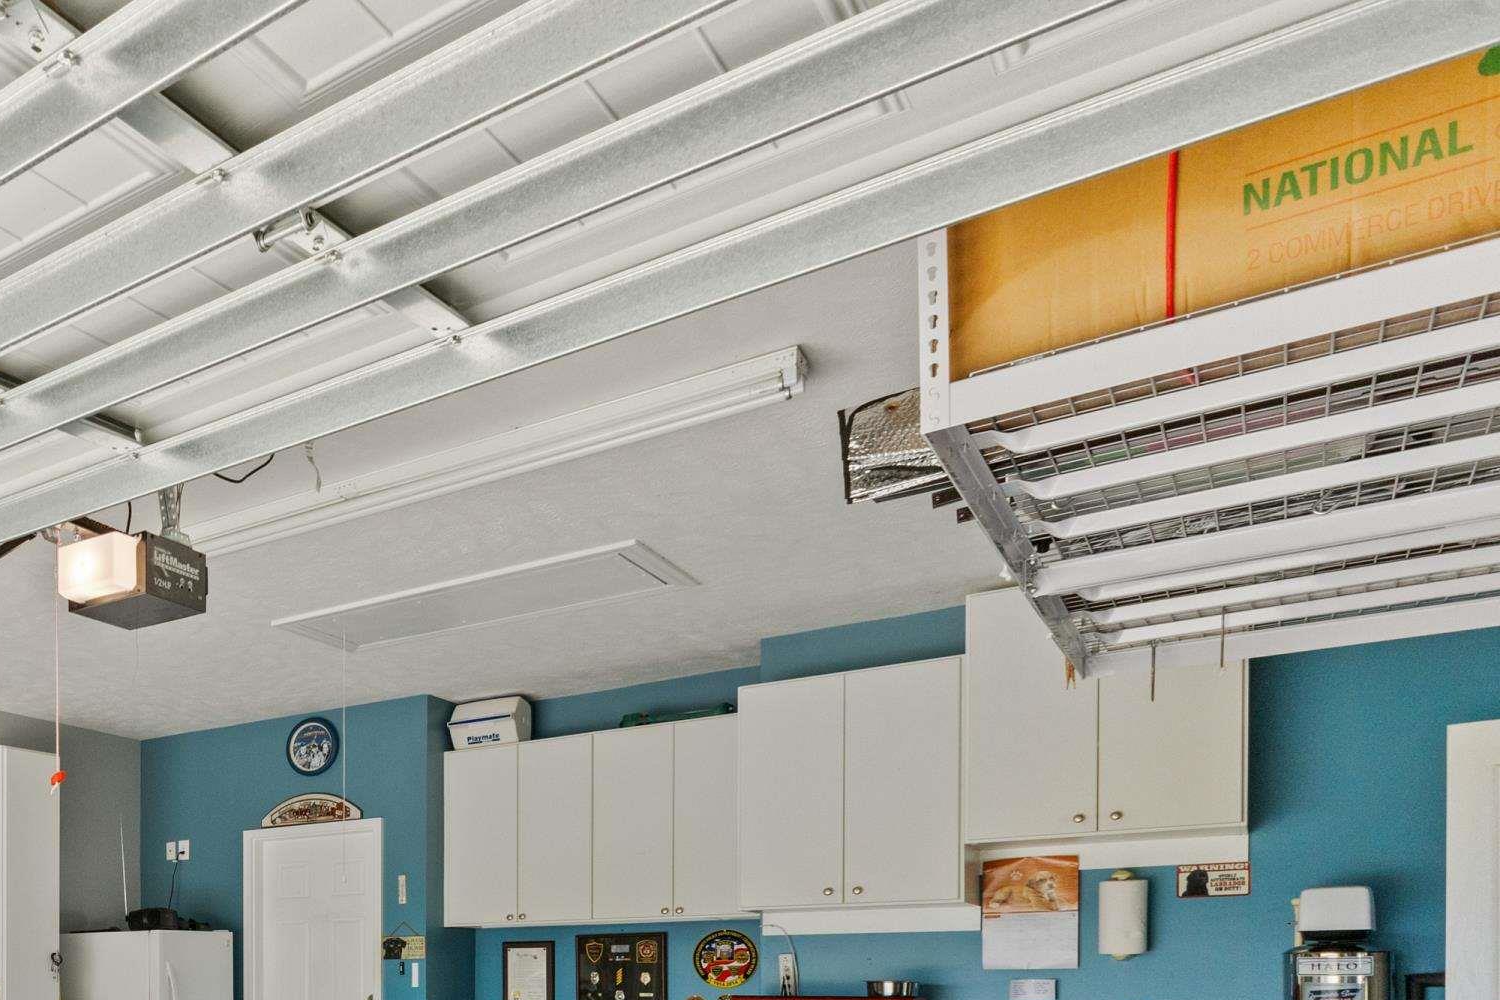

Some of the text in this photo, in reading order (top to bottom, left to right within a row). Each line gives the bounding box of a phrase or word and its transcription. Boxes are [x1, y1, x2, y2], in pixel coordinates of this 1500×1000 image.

[1243, 120, 1474, 216] NATIONAL
[466, 733, 500, 743] Playmate
[1178, 862, 1249, 872] WARNING!
[1311, 962, 1358, 971] HALO
